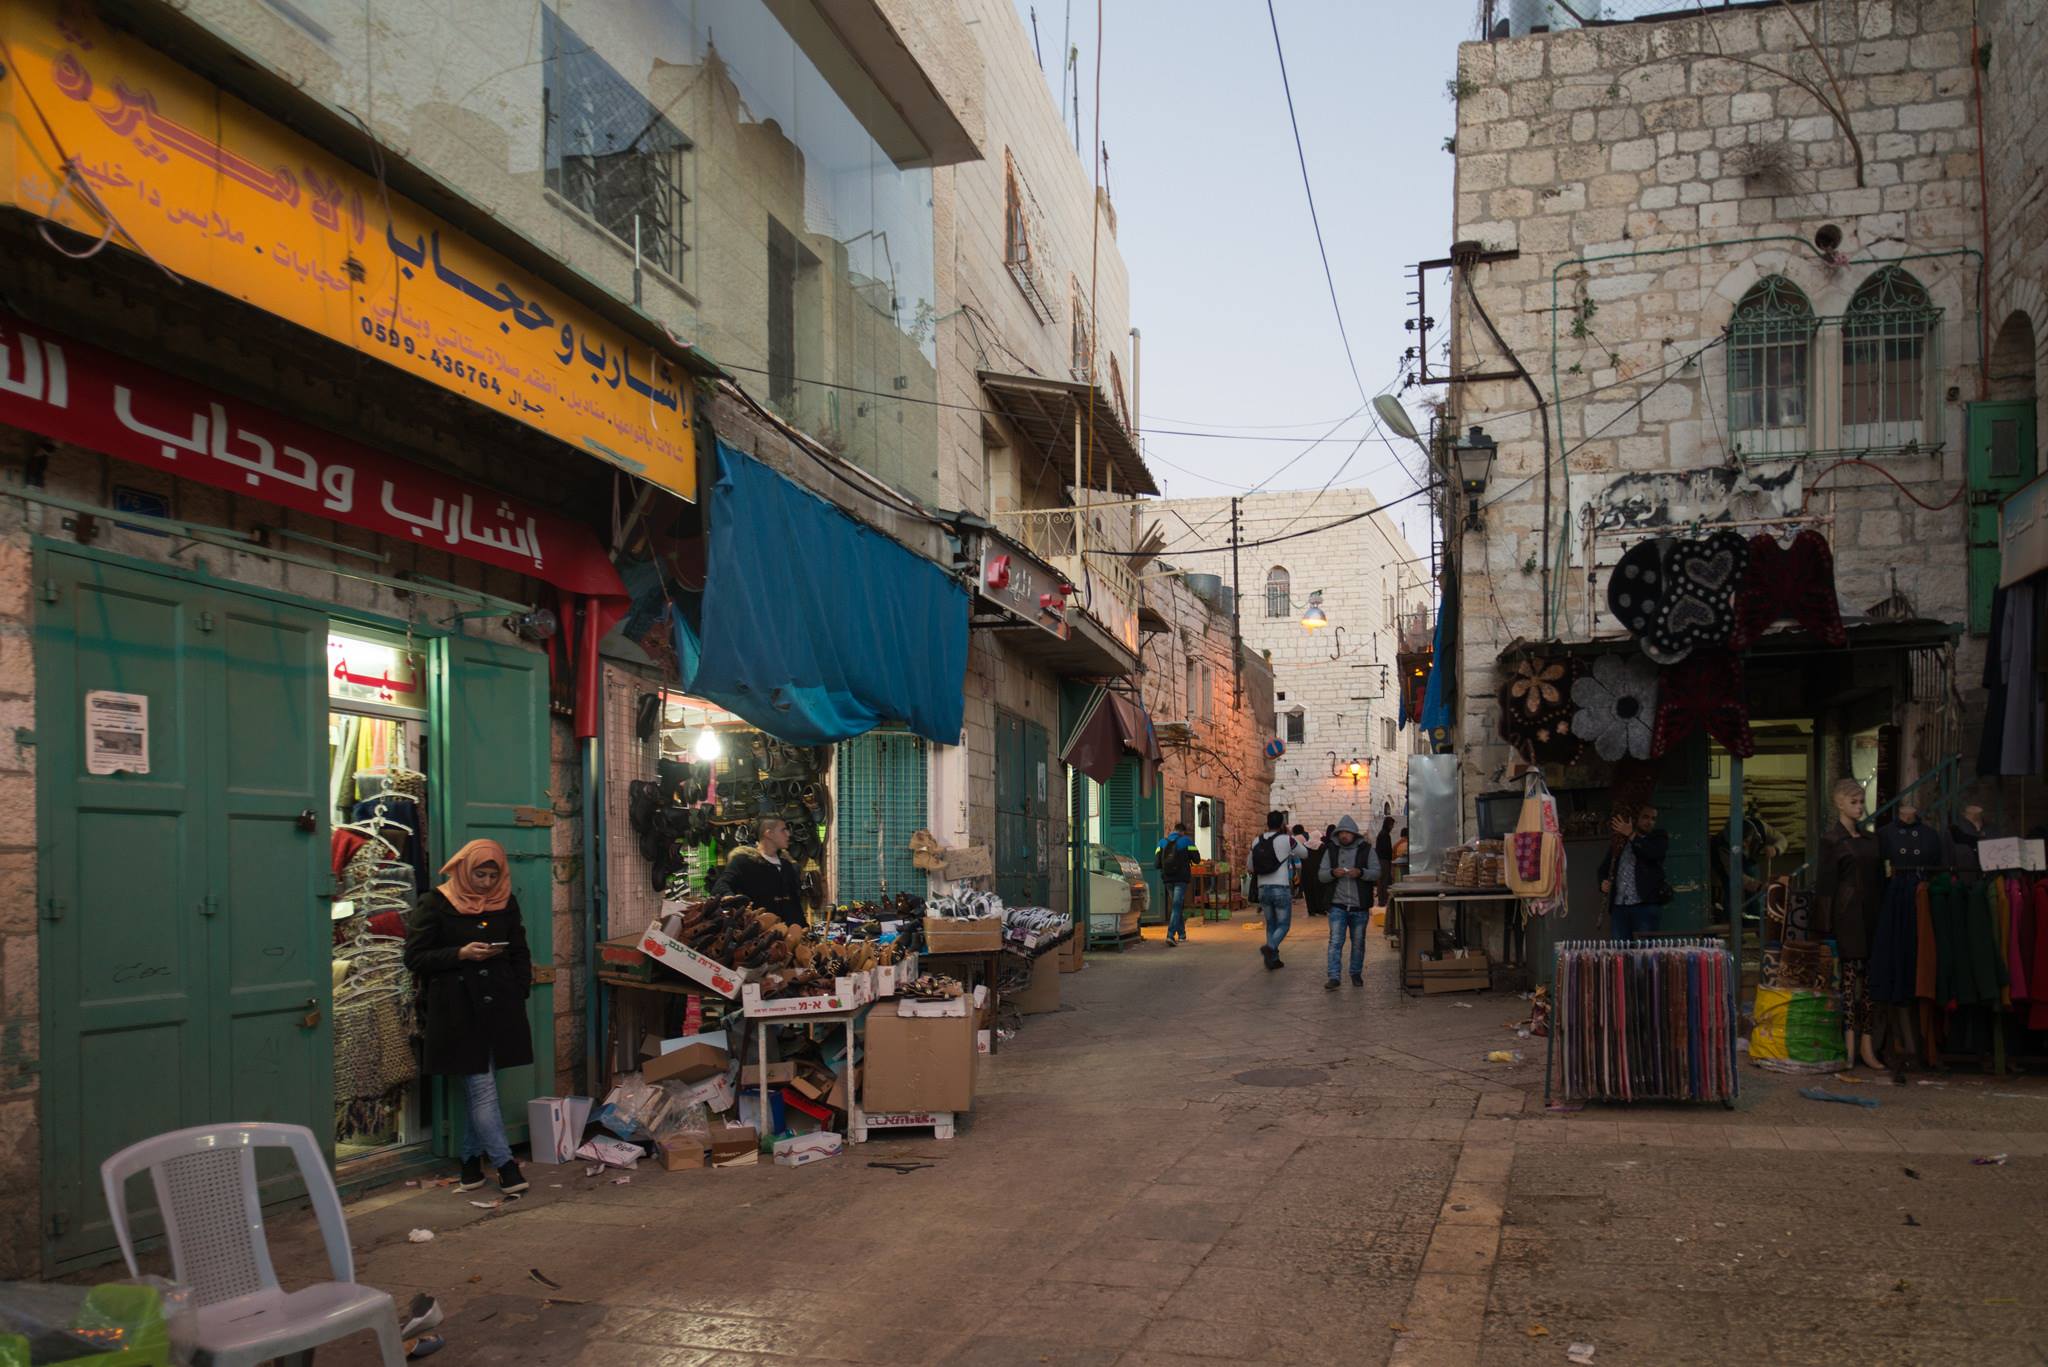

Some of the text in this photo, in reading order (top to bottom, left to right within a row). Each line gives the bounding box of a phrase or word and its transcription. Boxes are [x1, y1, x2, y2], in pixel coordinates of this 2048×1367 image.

[167, 208, 245, 245] ملابس
[387, 223, 574, 366] وحجاب
[114, 385, 355, 513] وحجاب
[508, 389, 545, 419] جوال
[382, 480, 543, 570] إشارب
